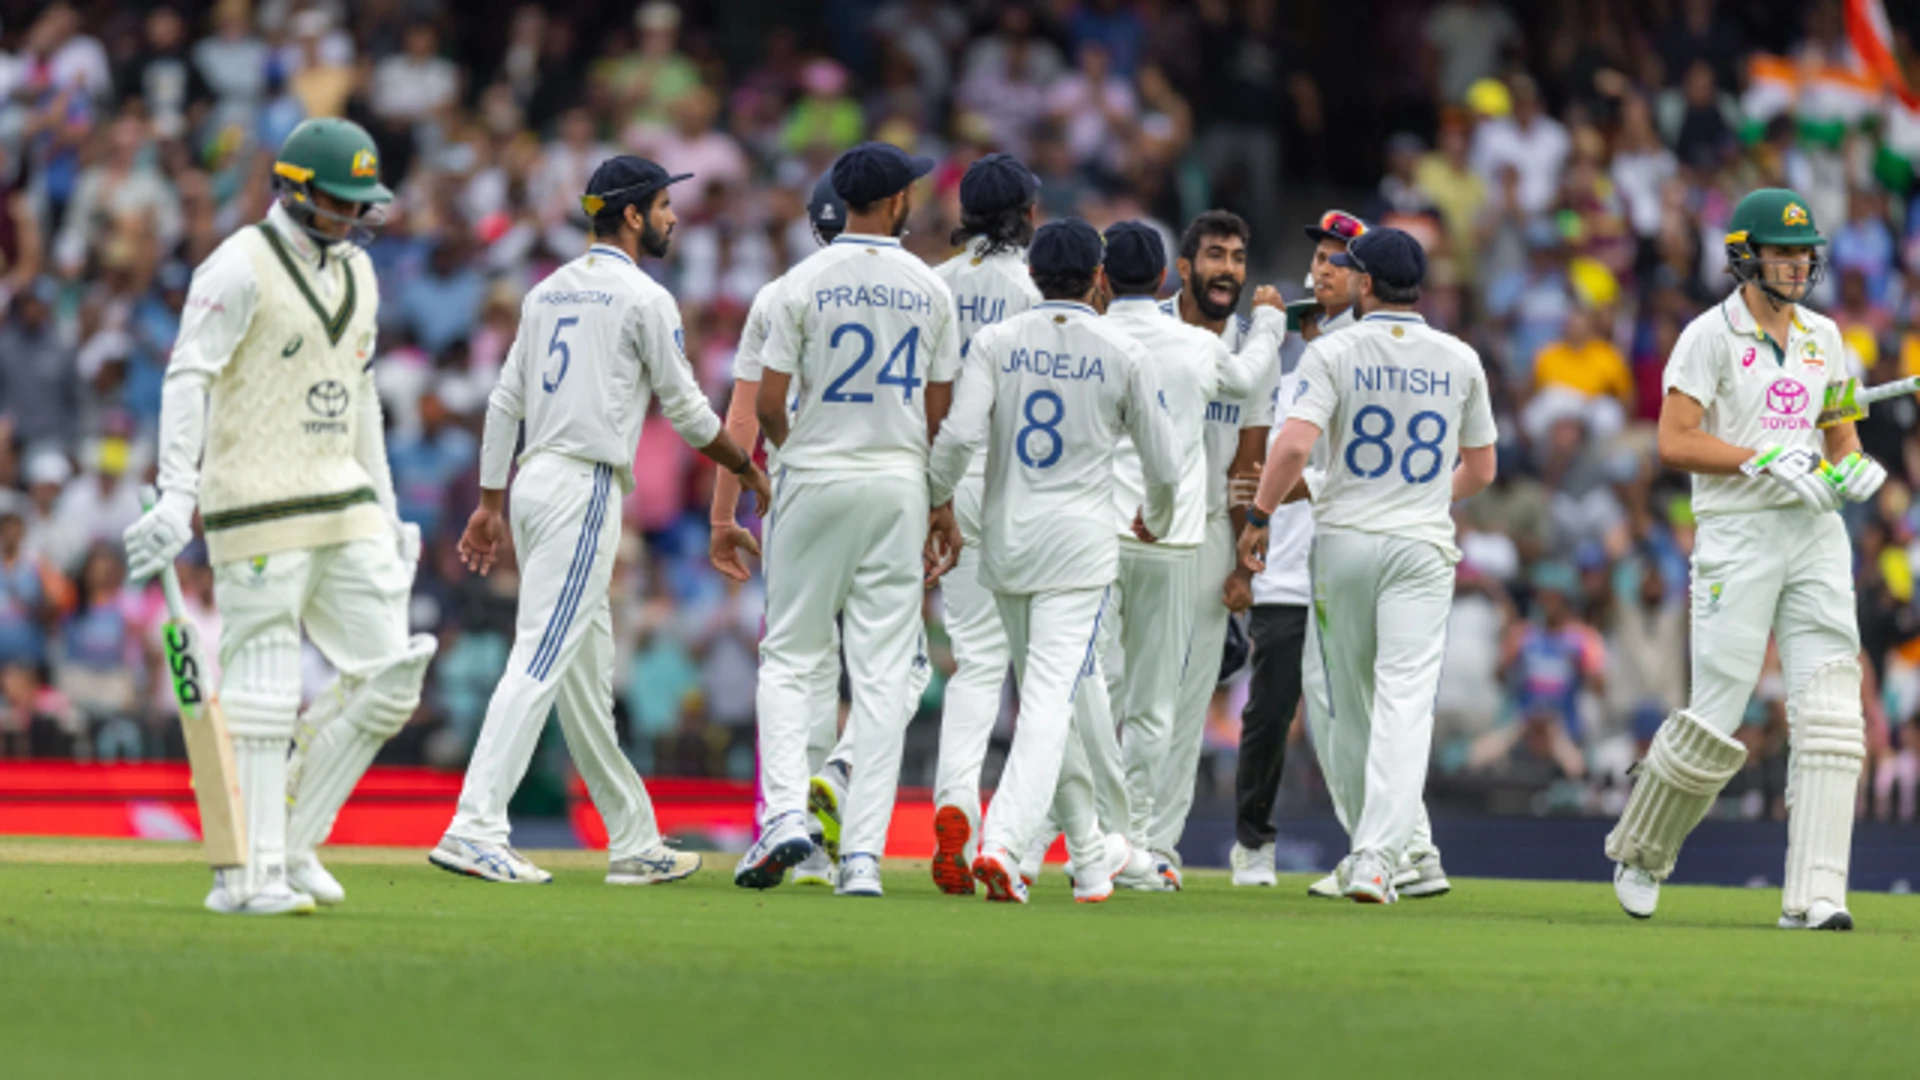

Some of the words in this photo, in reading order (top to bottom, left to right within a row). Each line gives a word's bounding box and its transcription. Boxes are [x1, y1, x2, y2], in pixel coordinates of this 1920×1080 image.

[815, 284, 931, 315] PRASIDH
[542, 316, 579, 394] 5
[822, 321, 922, 405] 24
[1001, 347, 1105, 383] JADEJA
[1354, 366, 1450, 396] NITISH
[1015, 389, 1065, 469] 8
[1344, 404, 1448, 484] 88
[167, 629, 202, 704] DSC
